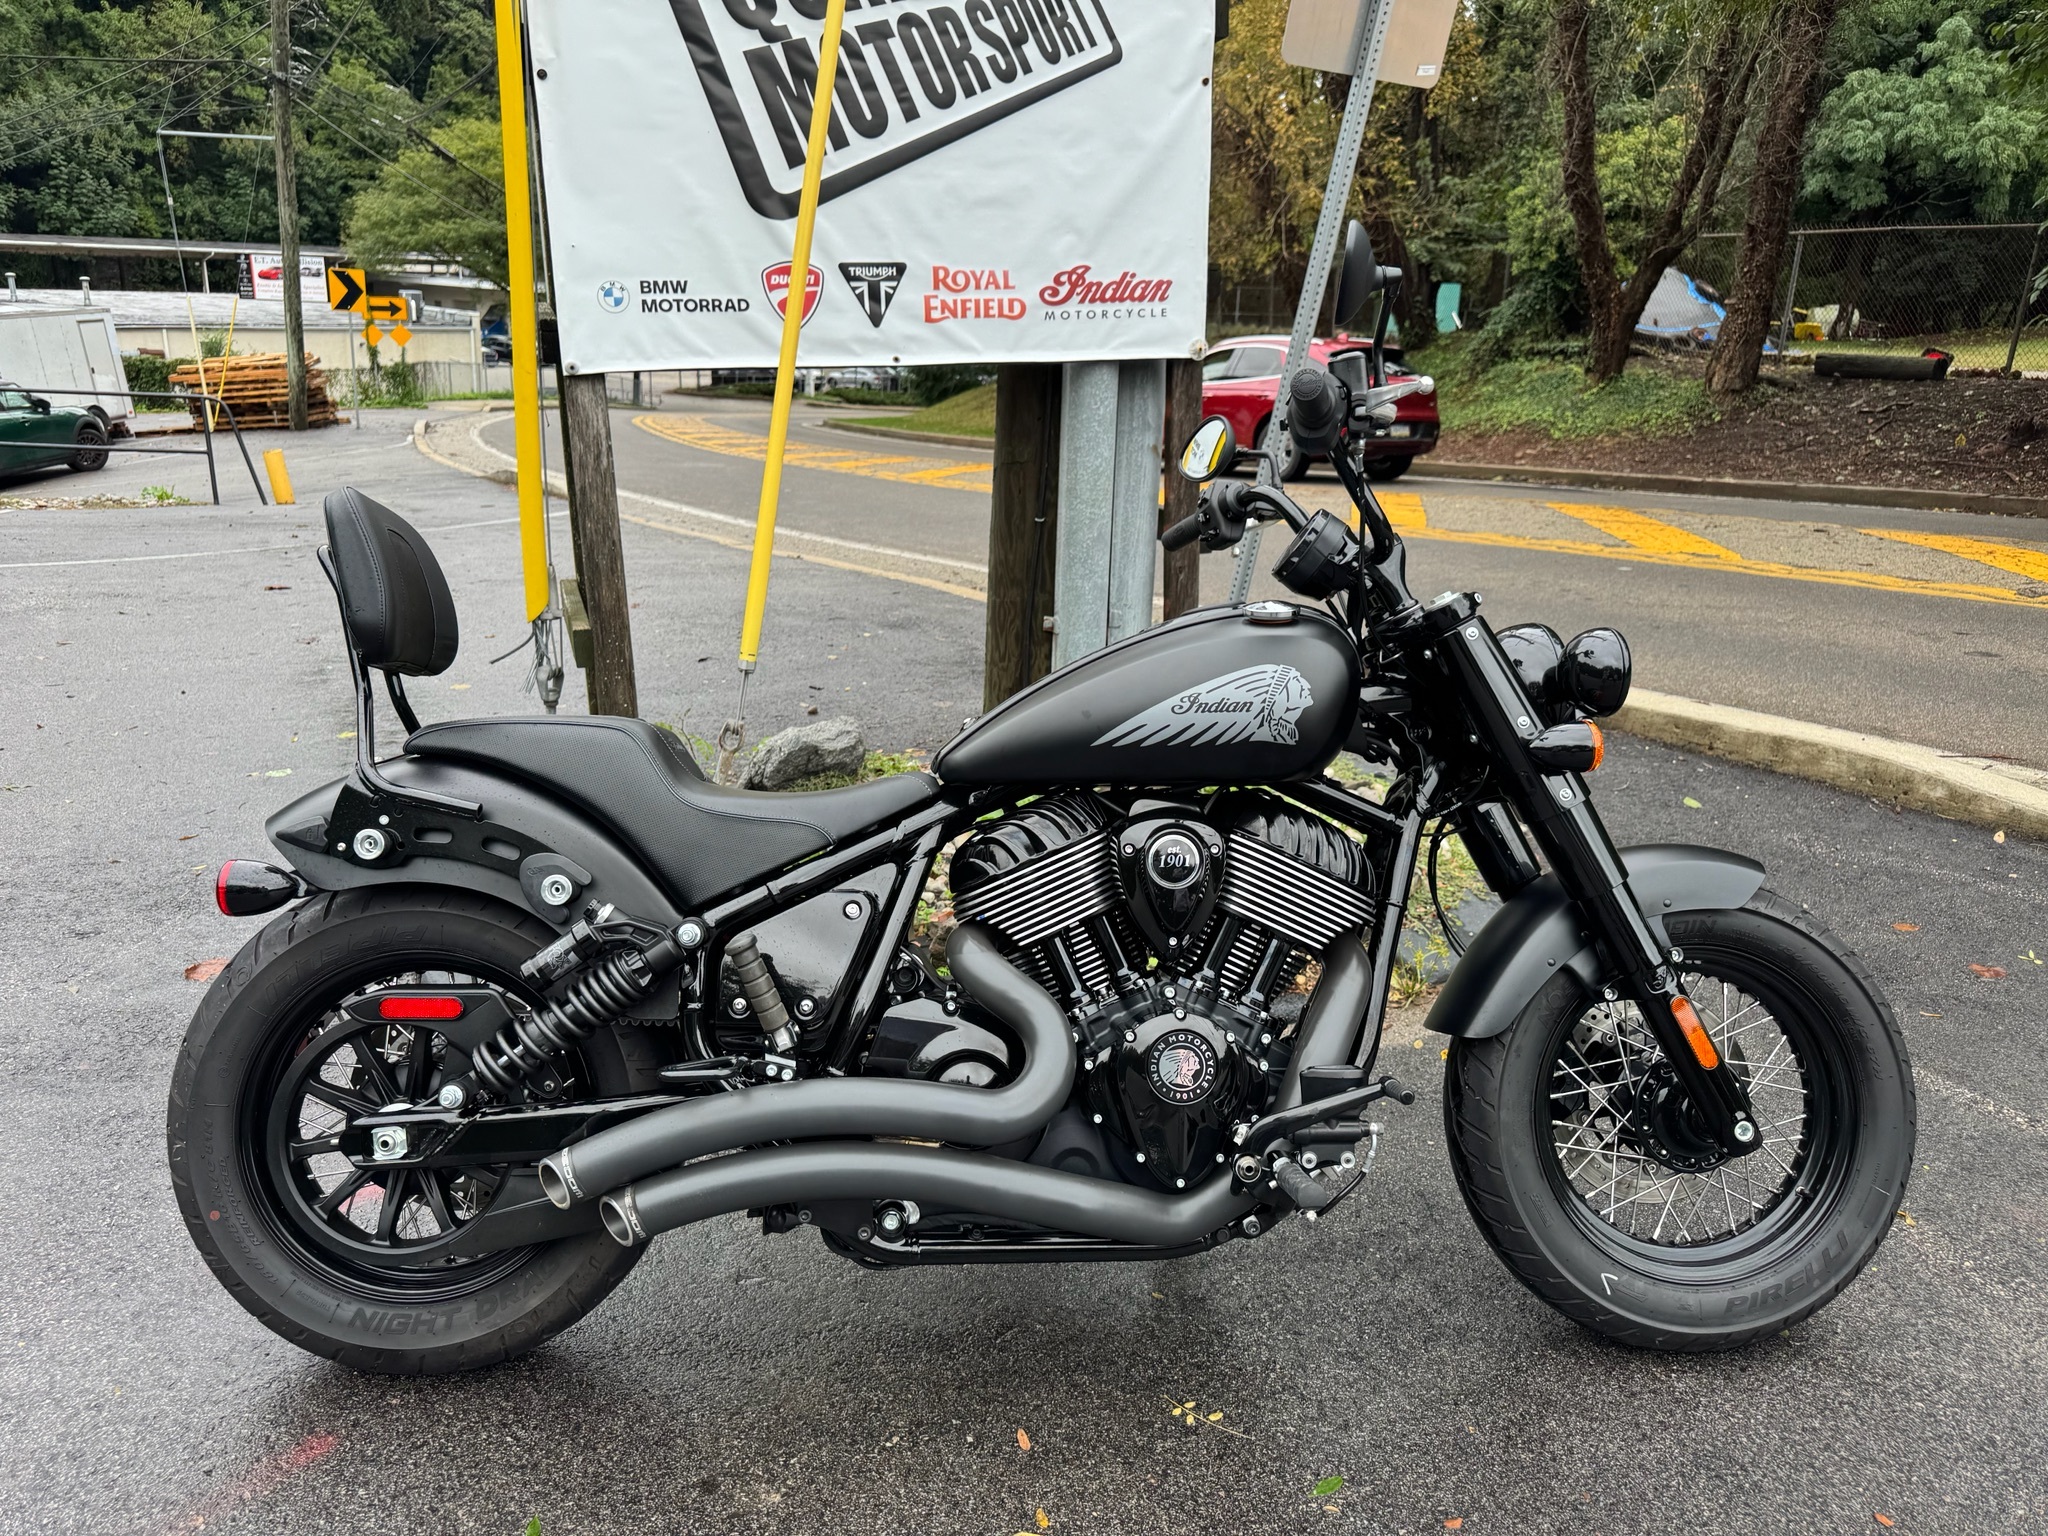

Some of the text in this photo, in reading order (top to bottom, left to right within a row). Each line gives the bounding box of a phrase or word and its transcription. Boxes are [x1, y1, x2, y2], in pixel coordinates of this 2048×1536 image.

[848, 265, 897, 279] TRIUMPH
[932, 265, 1016, 291] ROYAL
[640, 280, 688, 294] BMW
[1038, 264, 1174, 306] Indian
[641, 298, 750, 313] MOTORRAD
[923, 294, 1027, 323] ENFIELD
[1044, 307, 1168, 321] MOTORCYCLE
[1171, 693, 1255, 715] Indian
[1167, 845, 1182, 854] est.
[1159, 854, 1190, 868] 1901
[1150, 1034, 1214, 1089] INDIAN MOTORCYCLE
[1169, 1090, 1194, 1100] 1901
[1723, 1231, 1850, 1316] PIRELLI
[349, 1306, 463, 1335] NIGHT
